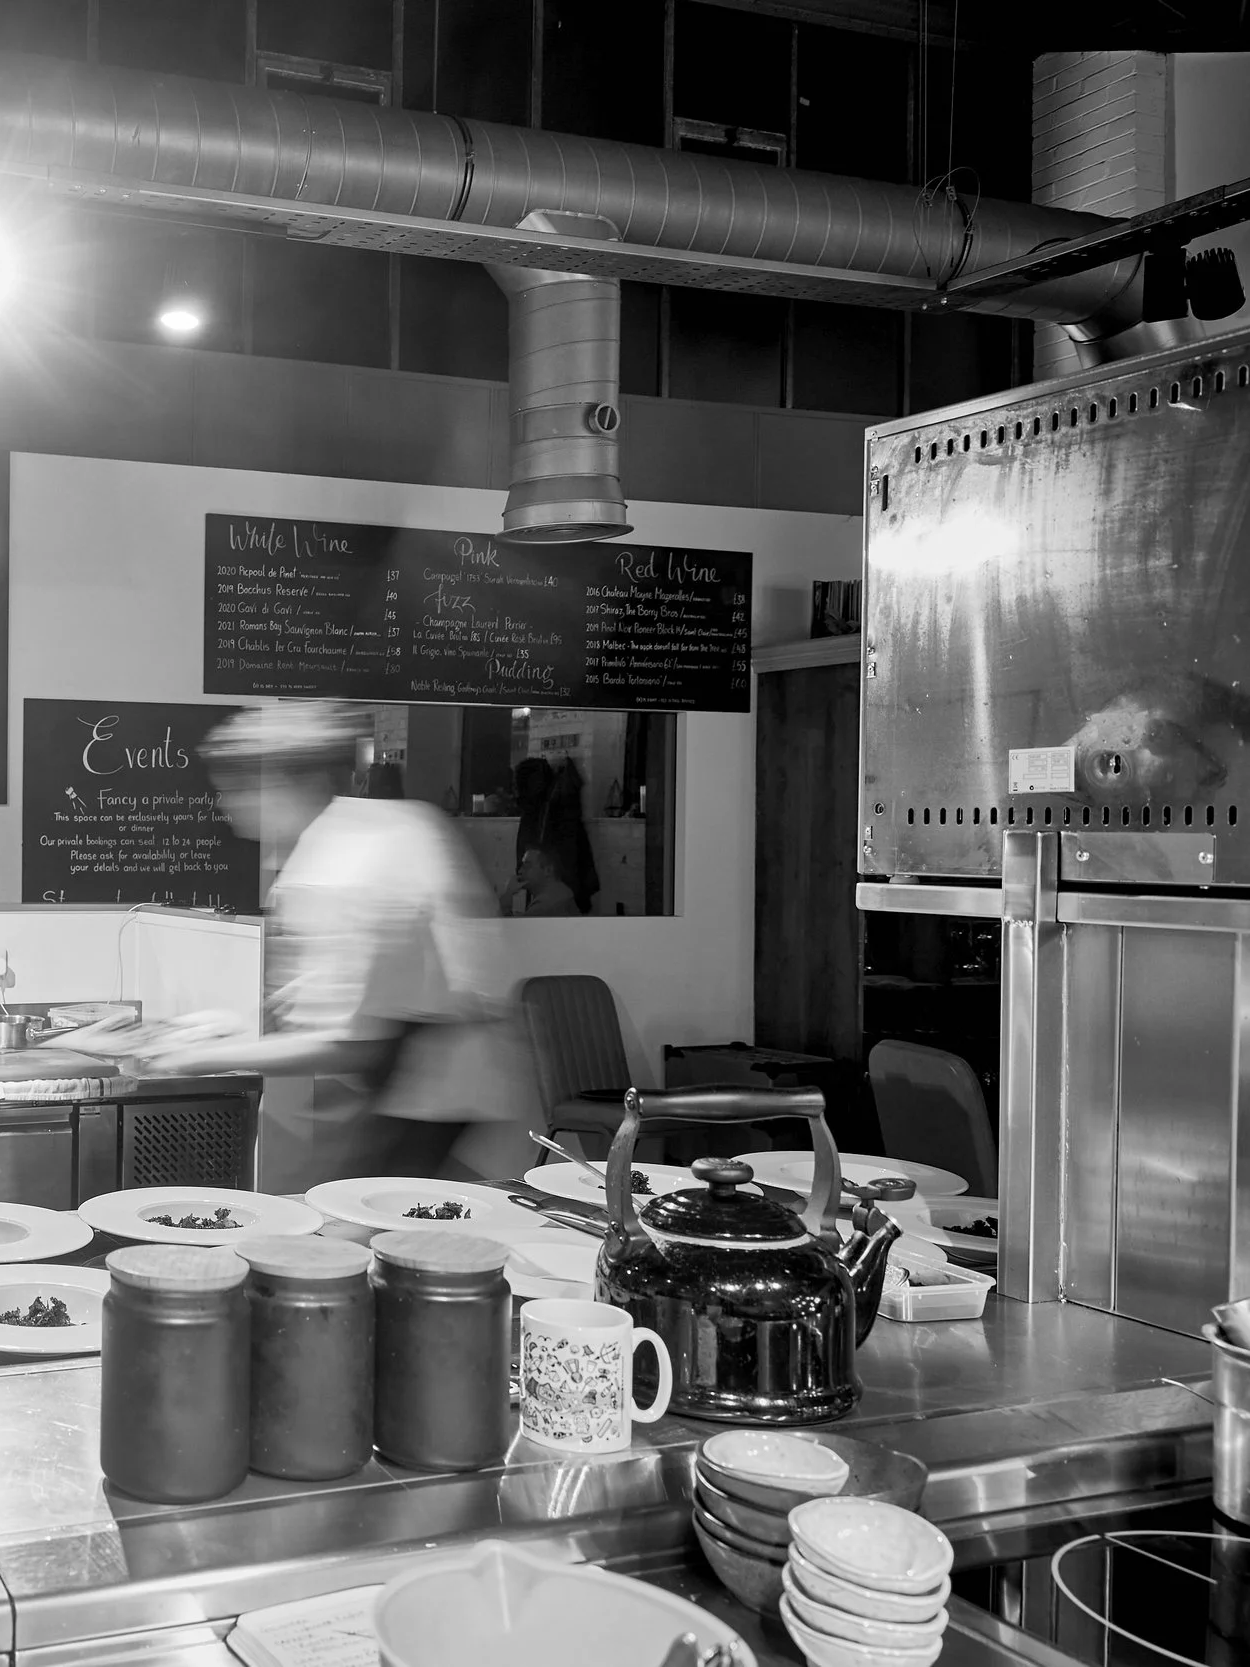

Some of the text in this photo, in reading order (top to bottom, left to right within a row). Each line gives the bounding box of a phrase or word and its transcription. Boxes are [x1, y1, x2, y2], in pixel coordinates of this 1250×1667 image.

[229, 521, 352, 558] White Wine
[454, 537, 499, 567] Pink
[217, 566, 236, 575] 2020
[239, 565, 265, 577] Picpoul
[268, 567, 277, 577] de
[279, 566, 296, 578] Pinet
[616, 552, 721, 584] Red Wine
[218, 584, 234, 594] 2019
[276, 583, 308, 596] Reserve
[586, 586, 600, 597] 2016
[218, 603, 235, 612] 2020
[238, 601, 257, 614] Gavi
[274, 602, 292, 614] Gavi
[586, 605, 599, 614] 2017
[218, 621, 235, 630] 2021
[270, 621, 282, 636] Bay
[285, 620, 322, 638] Sauvignon
[324, 622, 348, 636] Blanc
[423, 615, 467, 631] Champagne
[586, 624, 599, 632] 2019
[218, 640, 235, 649] 2019
[238, 637, 269, 651] Chablis
[217, 658, 235, 669] 2019
[586, 657, 599, 666] 2017
[485, 658, 554, 689] Pudding
[76, 715, 189, 775] Events
[97, 788, 137, 811] Fancy
[142, 796, 149, 805] a
[153, 790, 183, 810] private
[54, 811, 69, 822] This
[74, 813, 97, 824] space
[116, 811, 124, 821] be
[128, 811, 169, 824] exclusively
[173, 813, 193, 824] yours
[197, 811, 207, 823] for
[212, 811, 233, 822] lunch
[131, 823, 154, 832] dinner
[40, 835, 56, 847] Our
[57, 835, 82, 849] private
[120, 838, 134, 846] can
[138, 837, 155, 847] seat
[162, 837, 170, 846] 12
[172, 837, 179, 846] to
[182, 837, 190, 846] 24
[196, 836, 221, 849] people
[71, 850, 210, 862] Please ask for availability or leave
[71, 861, 228, 874] your details and we will get back to you
